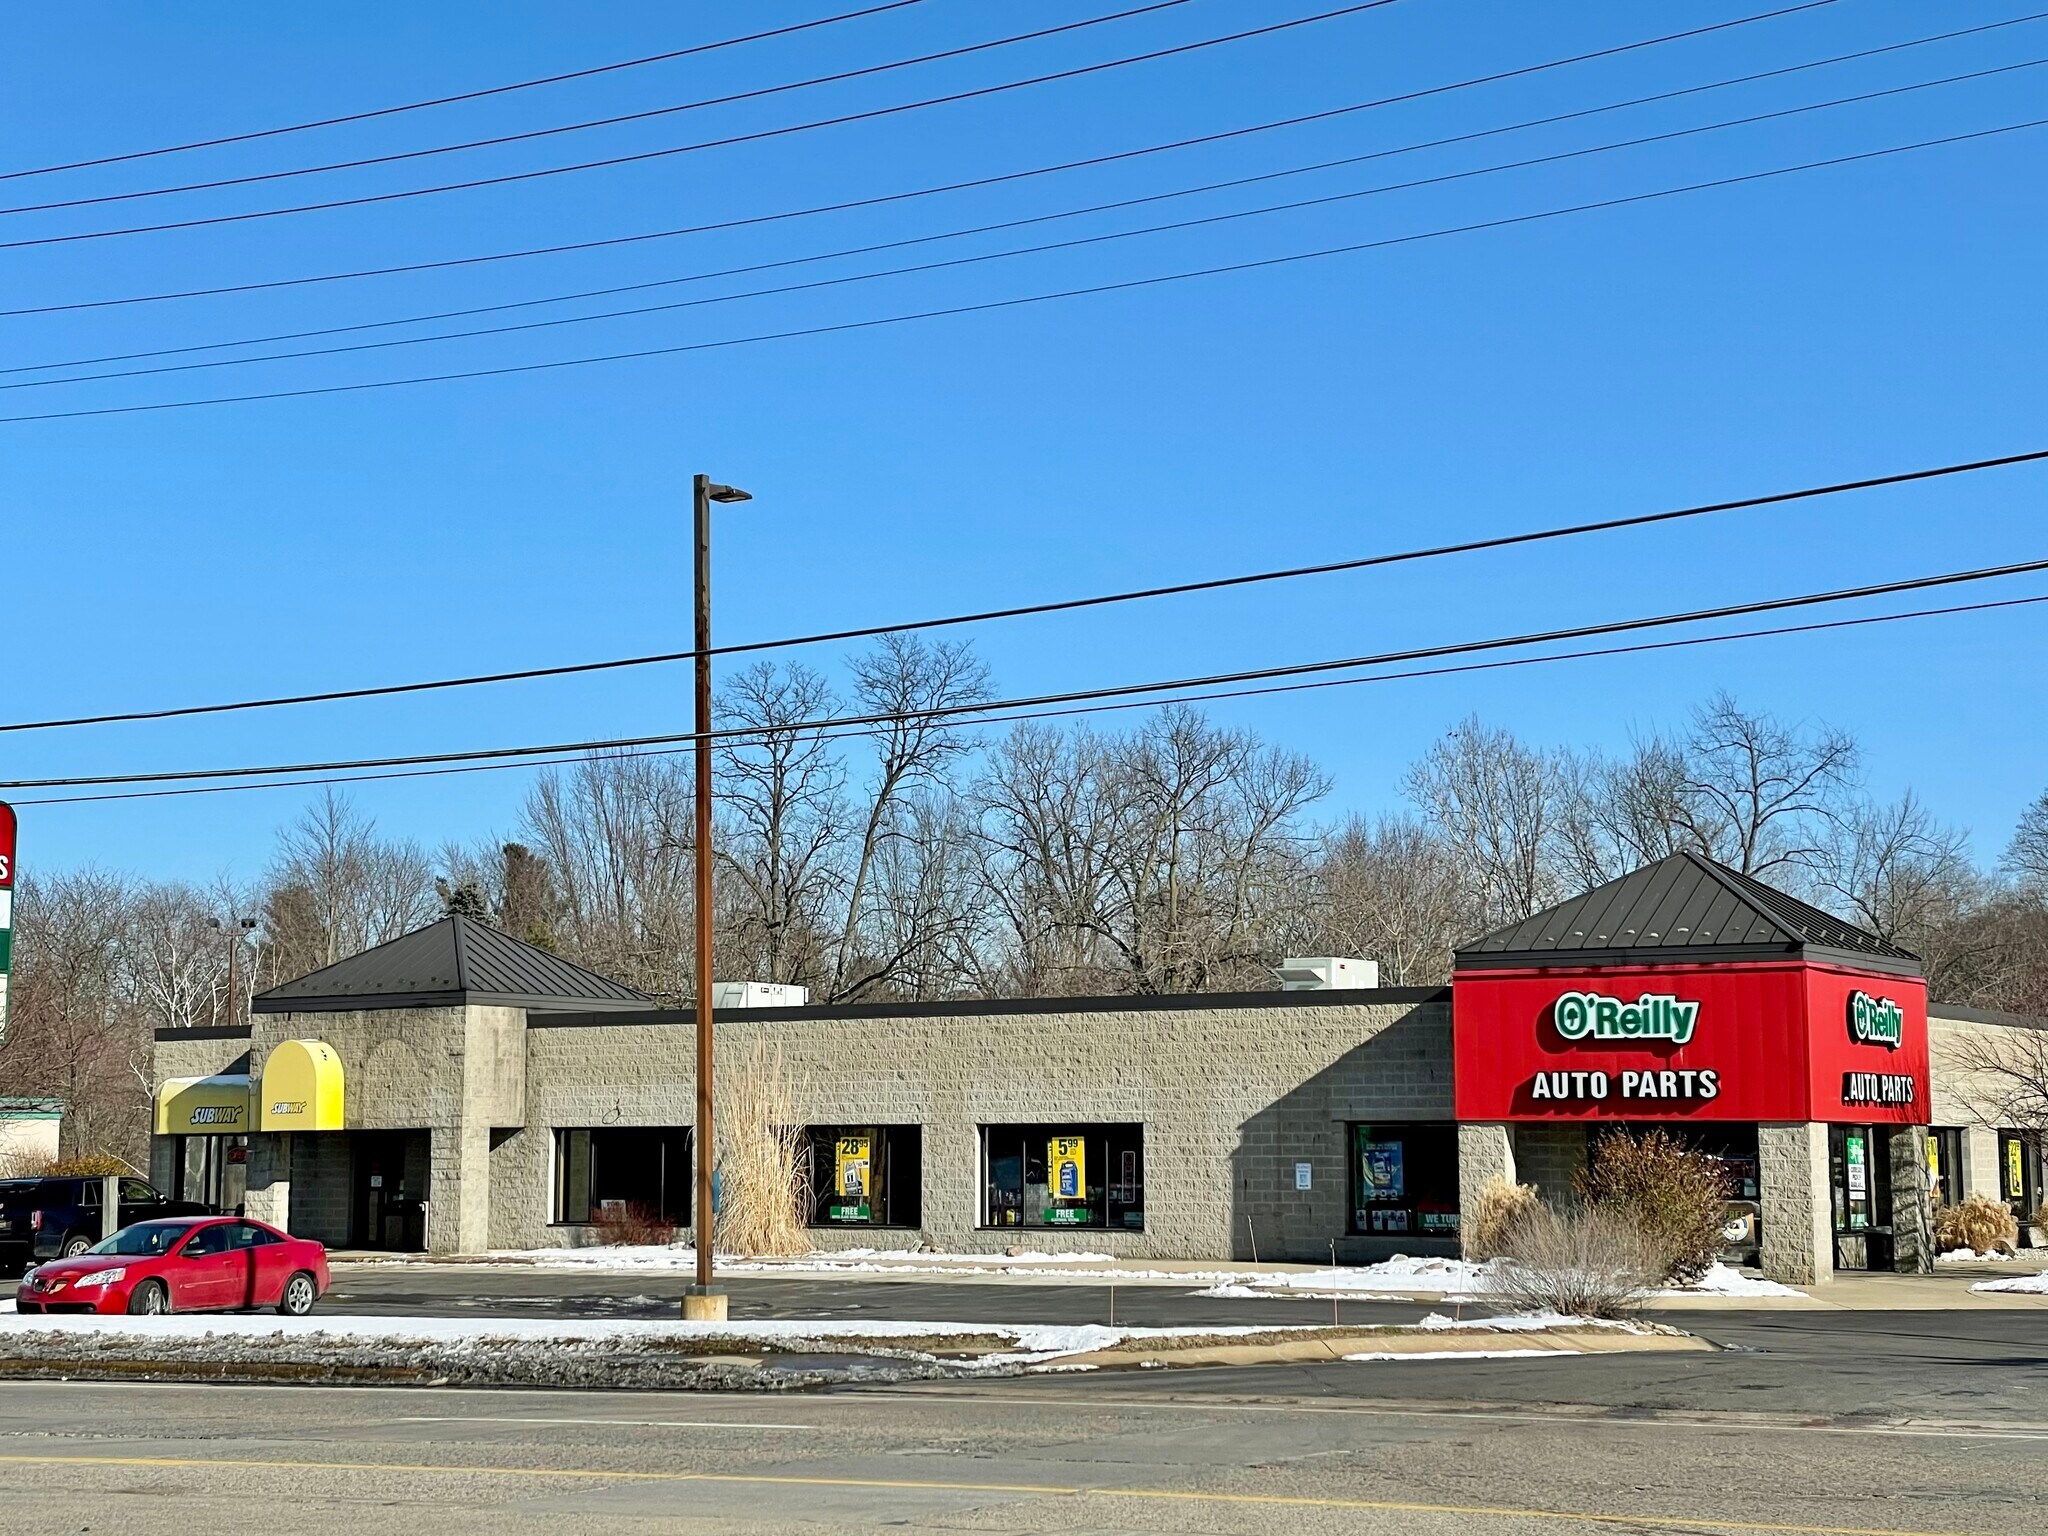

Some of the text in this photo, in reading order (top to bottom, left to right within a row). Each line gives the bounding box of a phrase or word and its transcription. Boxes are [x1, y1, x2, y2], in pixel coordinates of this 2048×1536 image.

[1555, 993, 1698, 1043] O'Reilly
[1855, 992, 1902, 1047] O'Reilly
[1532, 1069, 1718, 1099] AUTO PARTS
[1850, 1073, 1913, 1103] AUTO PARTS
[190, 1105, 243, 1125] SUBWAY
[271, 1101, 307, 1115] SUBWAY
[841, 1206, 858, 1216] FREE
[1055, 1208, 1075, 1218] FREE
[1425, 1214, 1439, 1223] WE
